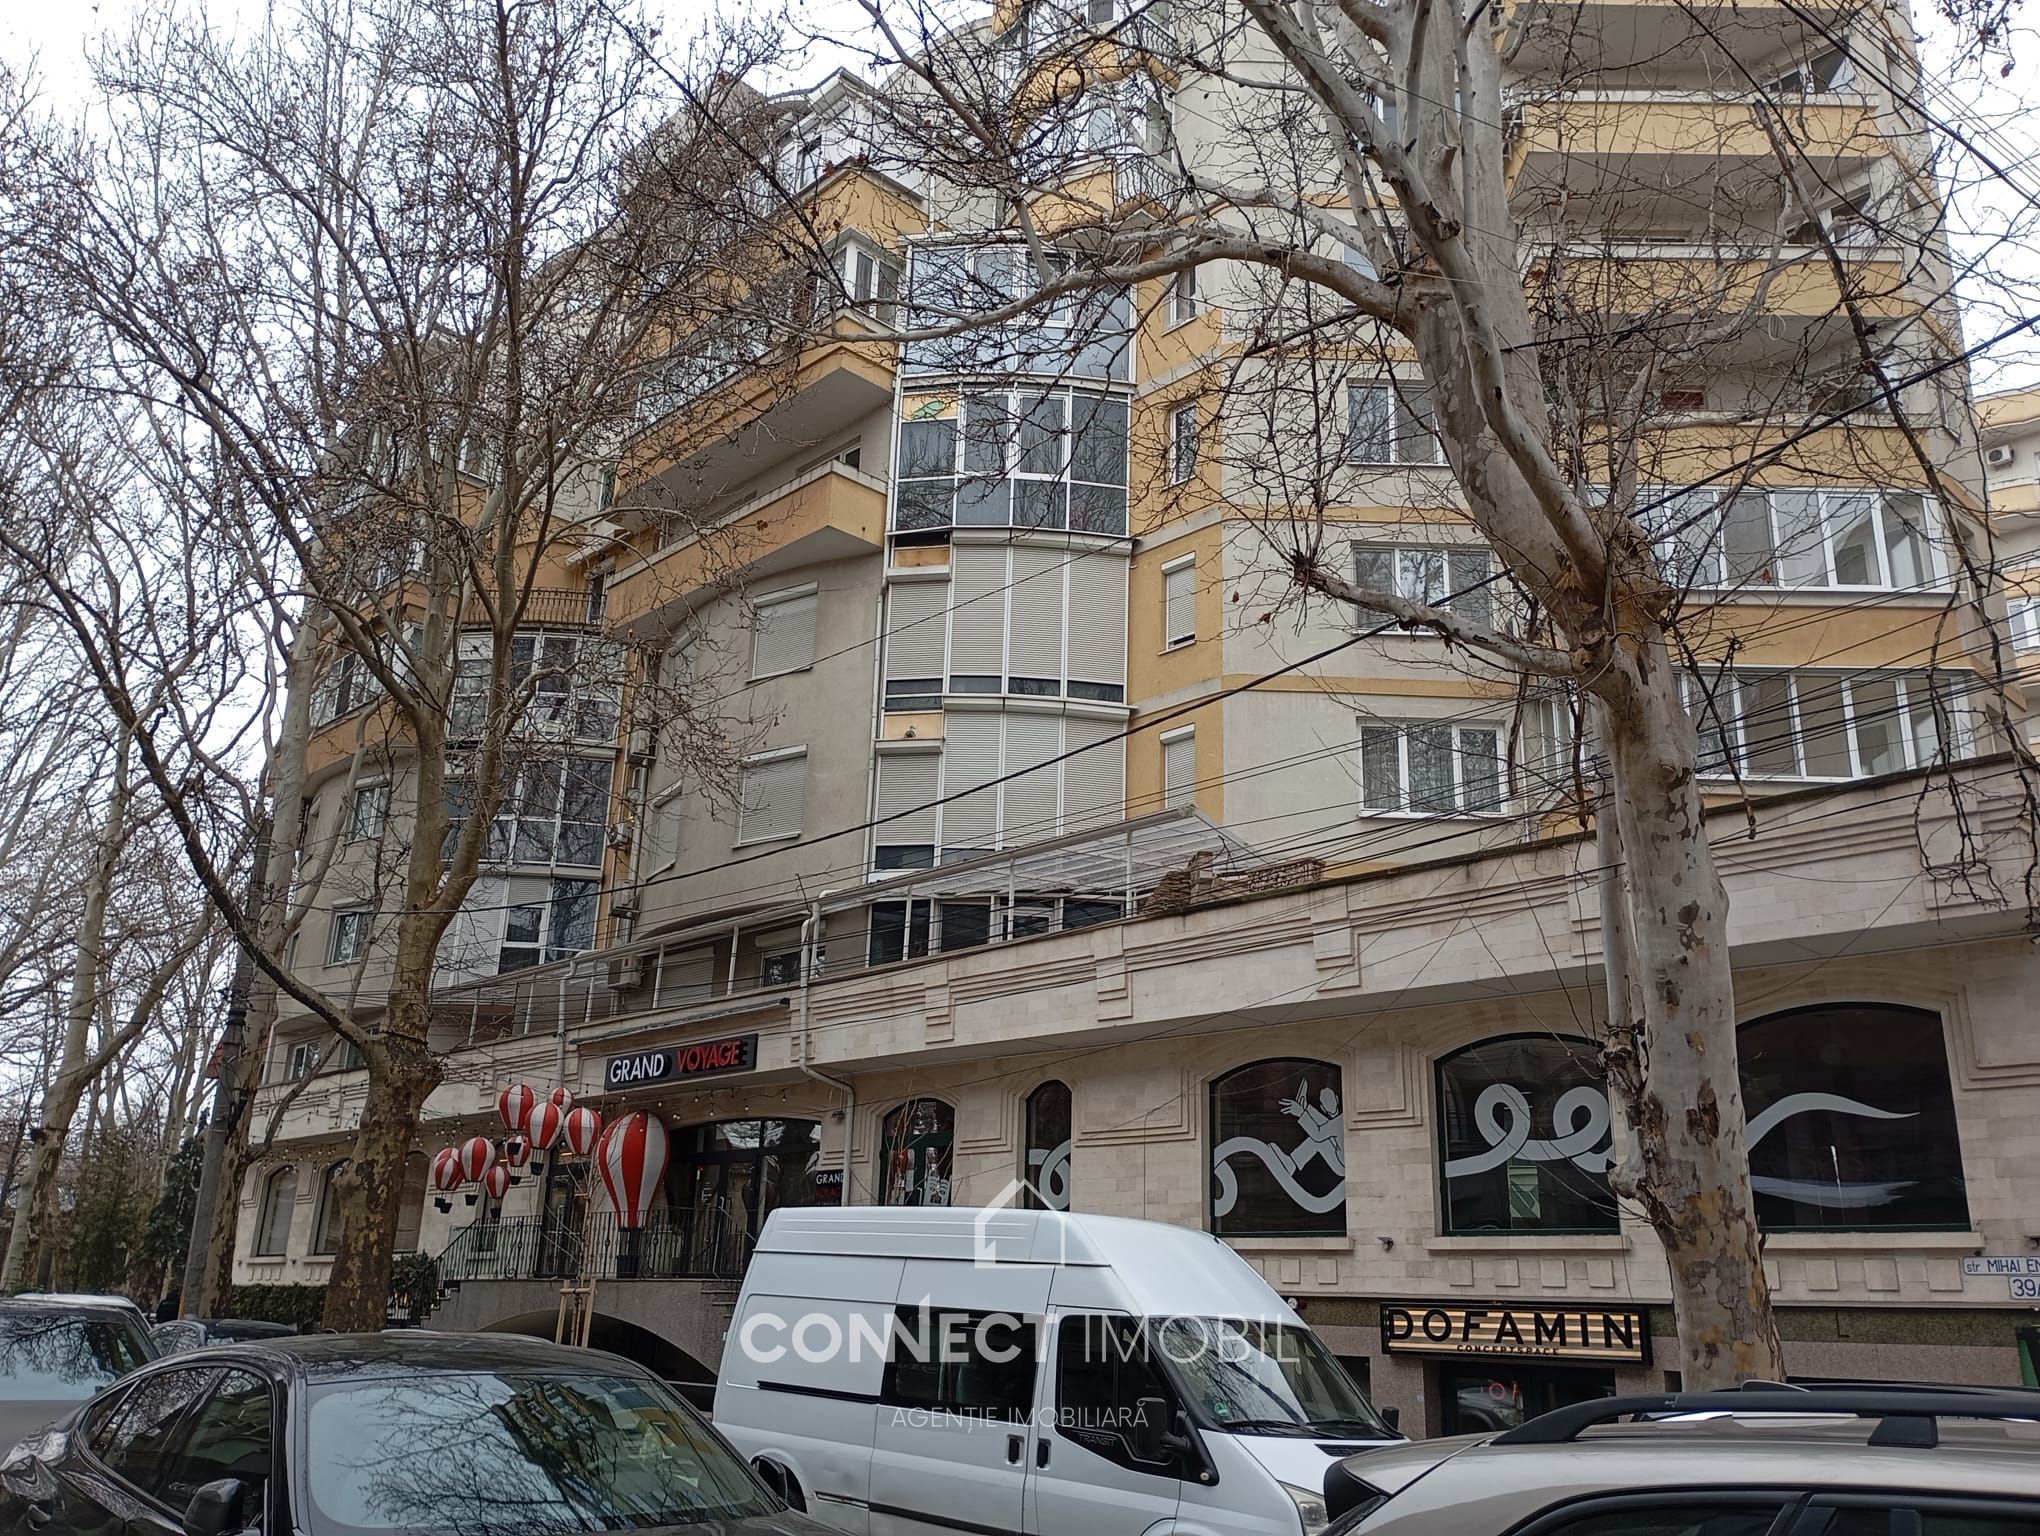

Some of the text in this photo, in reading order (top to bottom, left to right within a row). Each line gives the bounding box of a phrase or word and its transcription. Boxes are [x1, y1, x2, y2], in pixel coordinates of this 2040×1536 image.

[610, 1039, 742, 1083] GRAND VOYAGE
[1966, 1261, 1980, 1273] str
[1987, 1259, 2021, 1272] MIHAI
[2012, 1279, 2040, 1297] 39
[1388, 1308, 1634, 1349] DOFAMIN
[1456, 1344, 1560, 1356] CONCEPTSPACE
